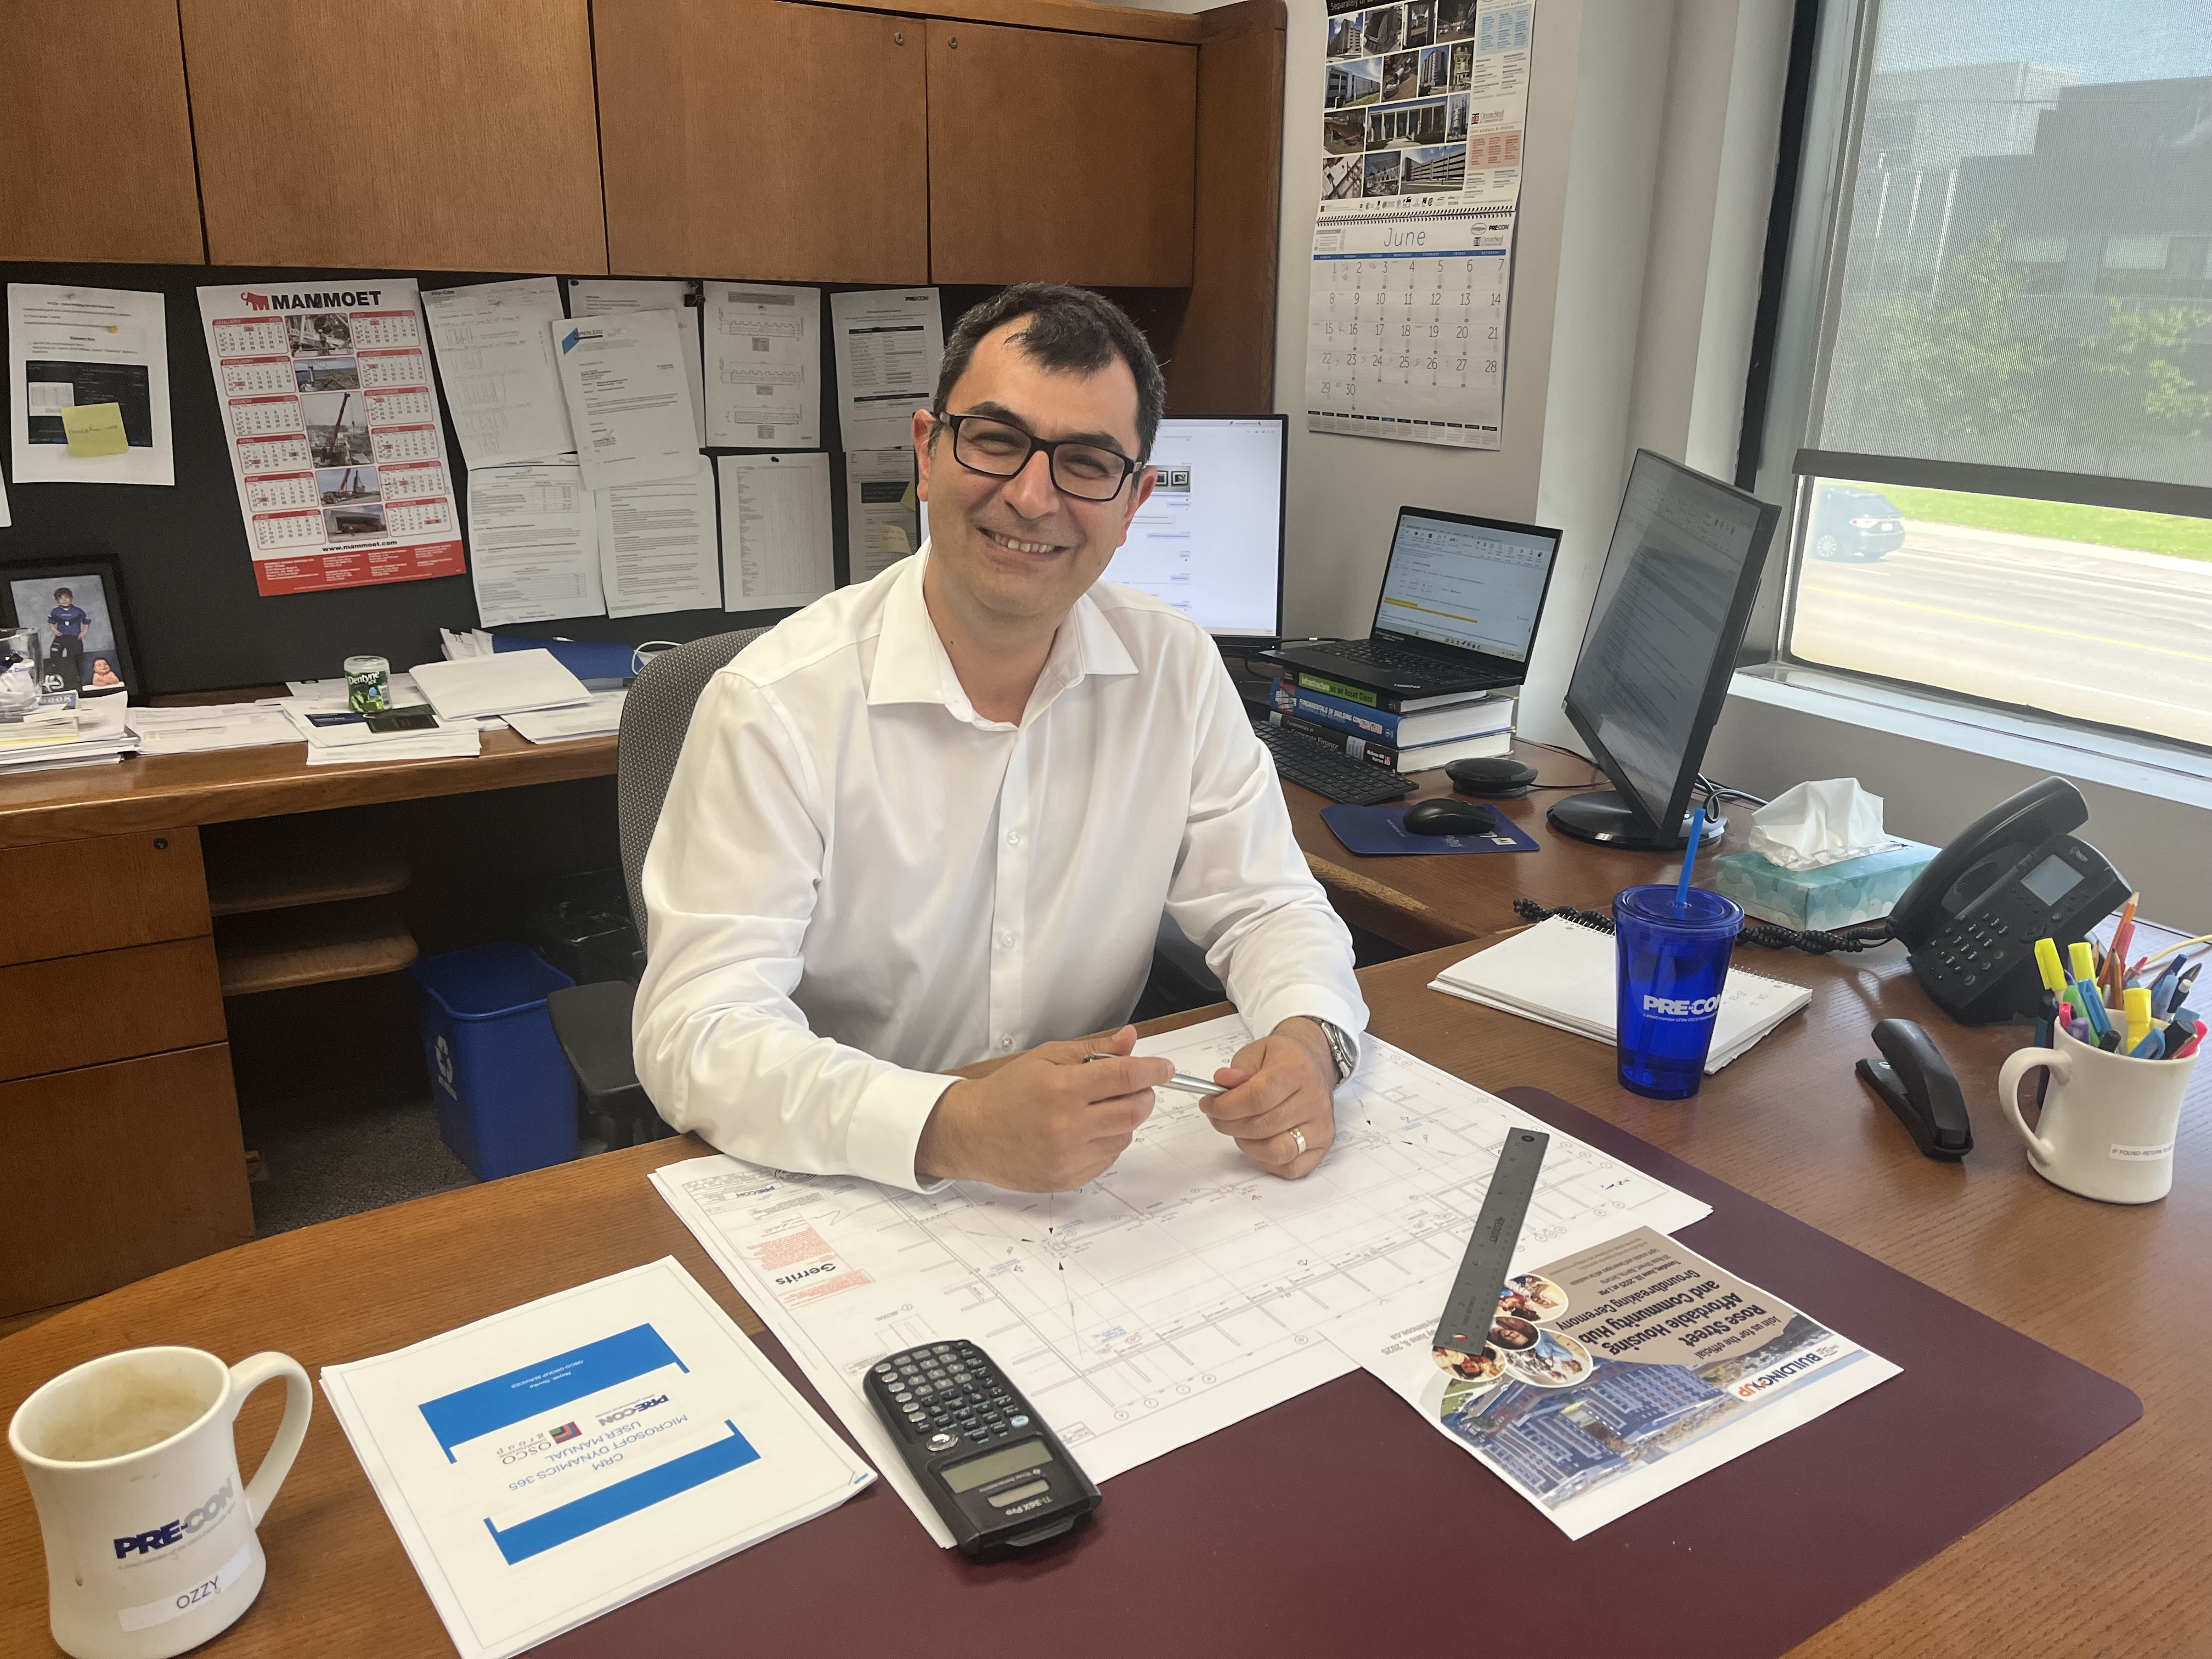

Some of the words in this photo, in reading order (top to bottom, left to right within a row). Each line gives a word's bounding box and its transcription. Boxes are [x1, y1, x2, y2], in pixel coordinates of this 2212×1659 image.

[1330, 0, 1357, 10] Separately
[1384, 228, 1425, 246] June
[1333, 263, 1336, 274] 1
[1357, 262, 1362, 274] 2
[1383, 261, 1387, 273] 3
[1409, 261, 1414, 272] 4
[1437, 260, 1443, 272] 5
[1467, 259, 1472, 272] 6
[1499, 259, 1504, 271] 7
[271, 290, 381, 310] MAMMOET
[1329, 292, 1335, 304] 8
[1355, 292, 1359, 304] 9
[1376, 292, 1385, 304] 10
[1404, 293, 1412, 305] 11
[1431, 293, 1441, 305] 12
[1460, 293, 1470, 306] 13
[1490, 294, 1500, 306] 14
[1325, 323, 1333, 334] 15
[1349, 324, 1358, 335] 16
[1375, 324, 1384, 335] 17
[1401, 325, 1410, 337] 18
[1429, 325, 1439, 337] 19
[1456, 326, 1468, 338] 20
[1488, 327, 1498, 339] 21
[1322, 353, 1331, 364] 22
[1347, 354, 1357, 365] 23
[1373, 355, 1382, 366] 24
[1399, 356, 1409, 368] 25
[1426, 358, 1437, 370] 26
[1456, 359, 1467, 371] 27
[1485, 360, 1497, 373] 28
[1321, 382, 1330, 393] 29
[1345, 383, 1356, 395] 30
[323, 540, 397, 551] www.mammoet.com
[348, 671, 380, 685] Dentyne
[1301, 676, 1329, 691] Infrastructure
[1345, 689, 1358, 699] Asset
[1359, 692, 1373, 703] Class
[1299, 698, 1328, 713] FUNDAMENTALS
[1334, 710, 1352, 721] BUILDING
[1352, 715, 1383, 731] CONSTRUCTION
[1318, 737, 1338, 750] Finance
[1643, 994, 1722, 1015] PRE-CON
[775, 1262, 837, 1286] Gerrits
[1618, 1279, 1636, 1288] 2025
[1610, 1269, 1701, 1308] Groundbreaking
[1688, 1280, 1720, 1299] and
[1555, 1304, 1618, 1331] Ceremony
[1605, 1293, 1695, 1330] Community
[1664, 1293, 1743, 1328] Affordable
[1724, 1304, 1767, 1325] Rose
[1751, 1323, 1763, 1331] us
[1763, 1316, 1782, 1327] Join
[1409, 1333, 1429, 1342] June
[1578, 1325, 1616, 1345] Hub
[1601, 1324, 1672, 1355] Housing
[1678, 1321, 1731, 1347] Street
[1726, 1334, 1742, 1345] the
[1741, 1327, 1756, 1339] for
[1381, 1344, 1404, 1355] 2025
[1694, 1342, 1725, 1359] official
[542, 1367, 565, 1378] GROUP
[565, 1360, 584, 1369] OSCO
[1758, 1352, 1823, 1387] BUILDING
[511, 1375, 541, 1389] SERVICES
[1738, 1379, 1759, 1397] UP
[598, 1394, 669, 1426] PRE-CON
[607, 1421, 642, 1440] USER
[612, 1414, 688, 1450] MICROSOFT
[499, 1437, 547, 1458] construction
[502, 1441, 552, 1465] OSCO
[544, 1437, 604, 1463] MANUAL
[537, 1446, 610, 1480] DYNAMICS
[591, 1453, 624, 1471] CRM
[508, 1475, 535, 1491] 365
[114, 1476, 234, 1559] PRE-CON
[1005, 1506, 1023, 1515] Pro
[176, 1575, 218, 1609] OZZY
